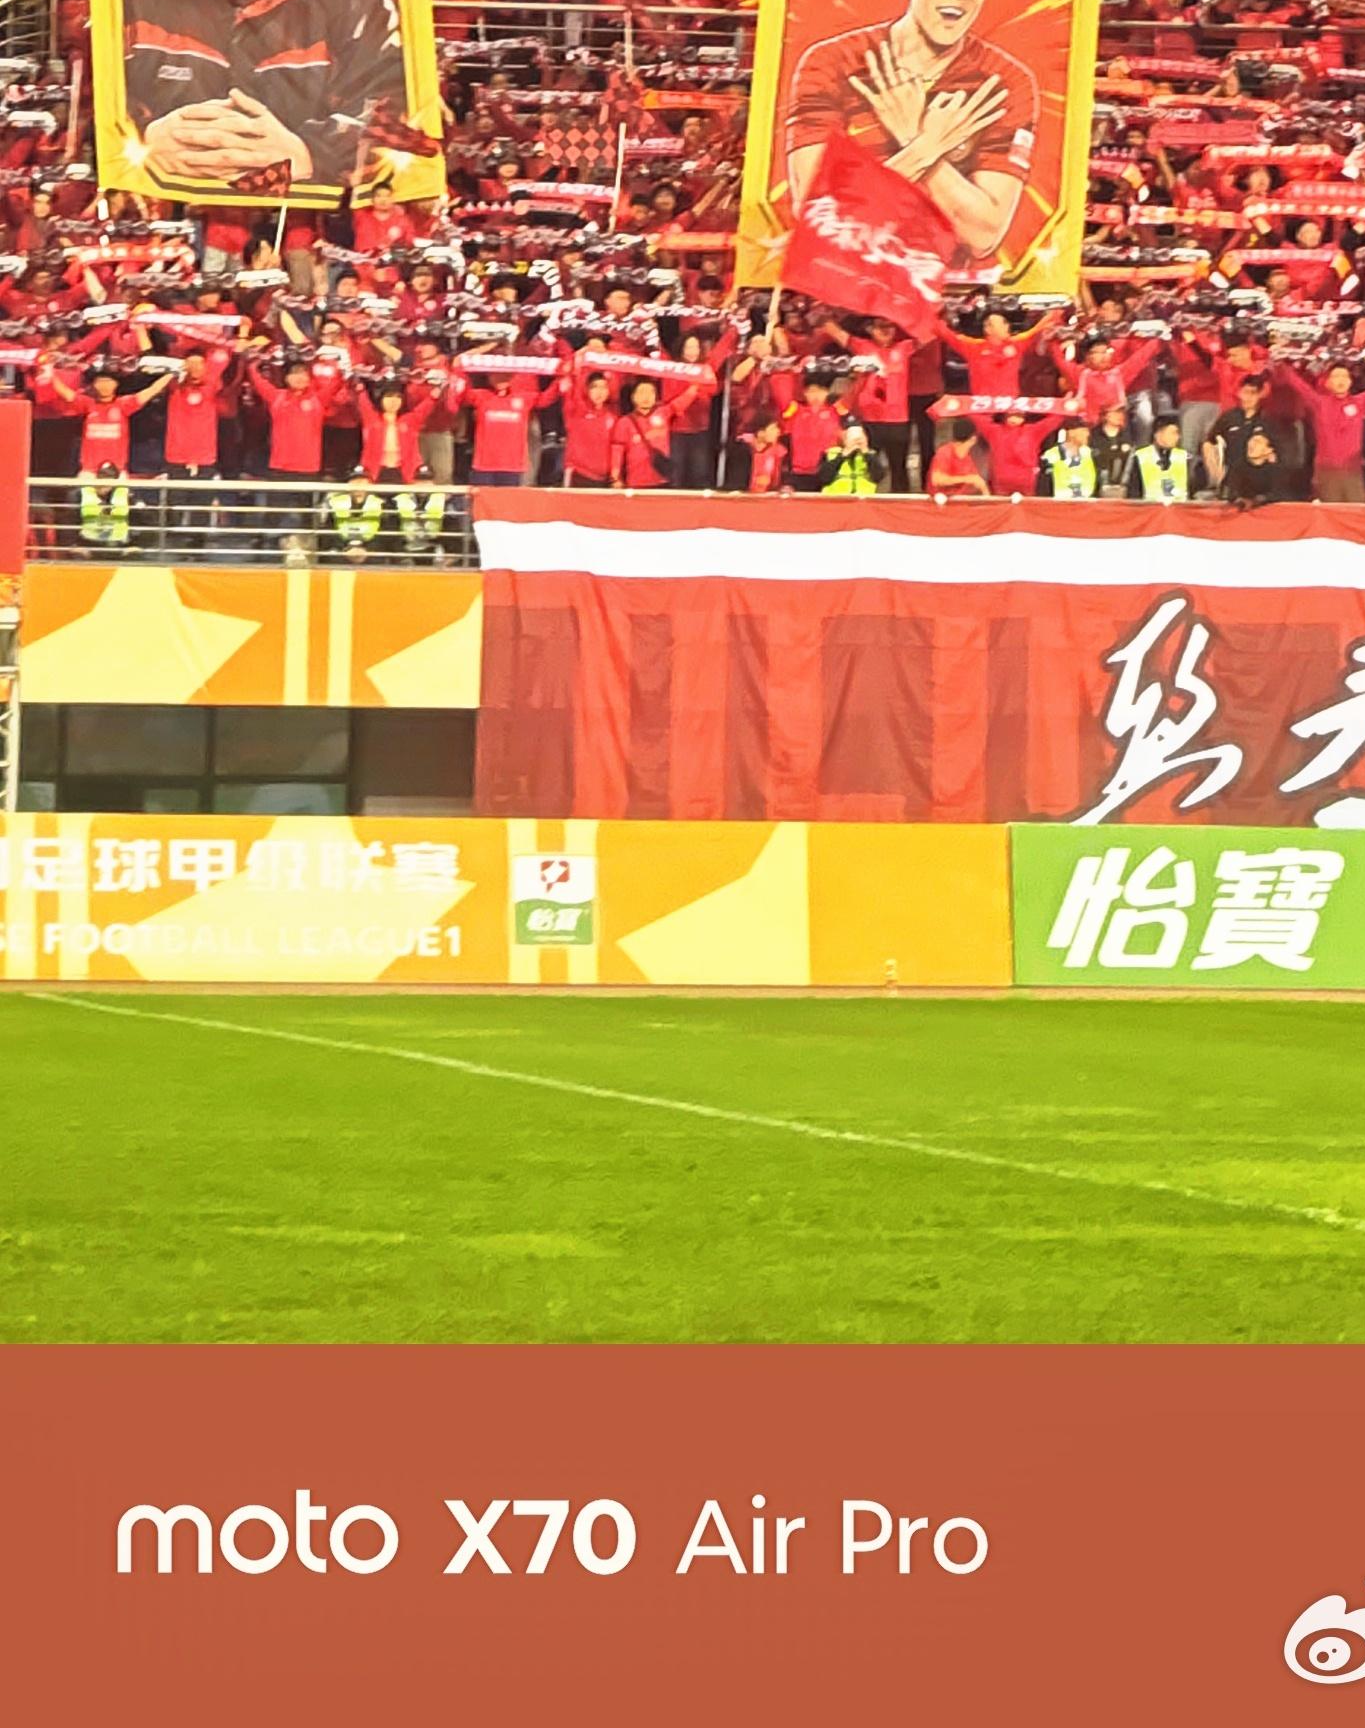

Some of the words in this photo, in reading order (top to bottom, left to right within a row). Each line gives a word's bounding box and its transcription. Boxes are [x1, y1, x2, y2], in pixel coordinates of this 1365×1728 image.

[0, 837, 461, 894] 足球甲级联赛
